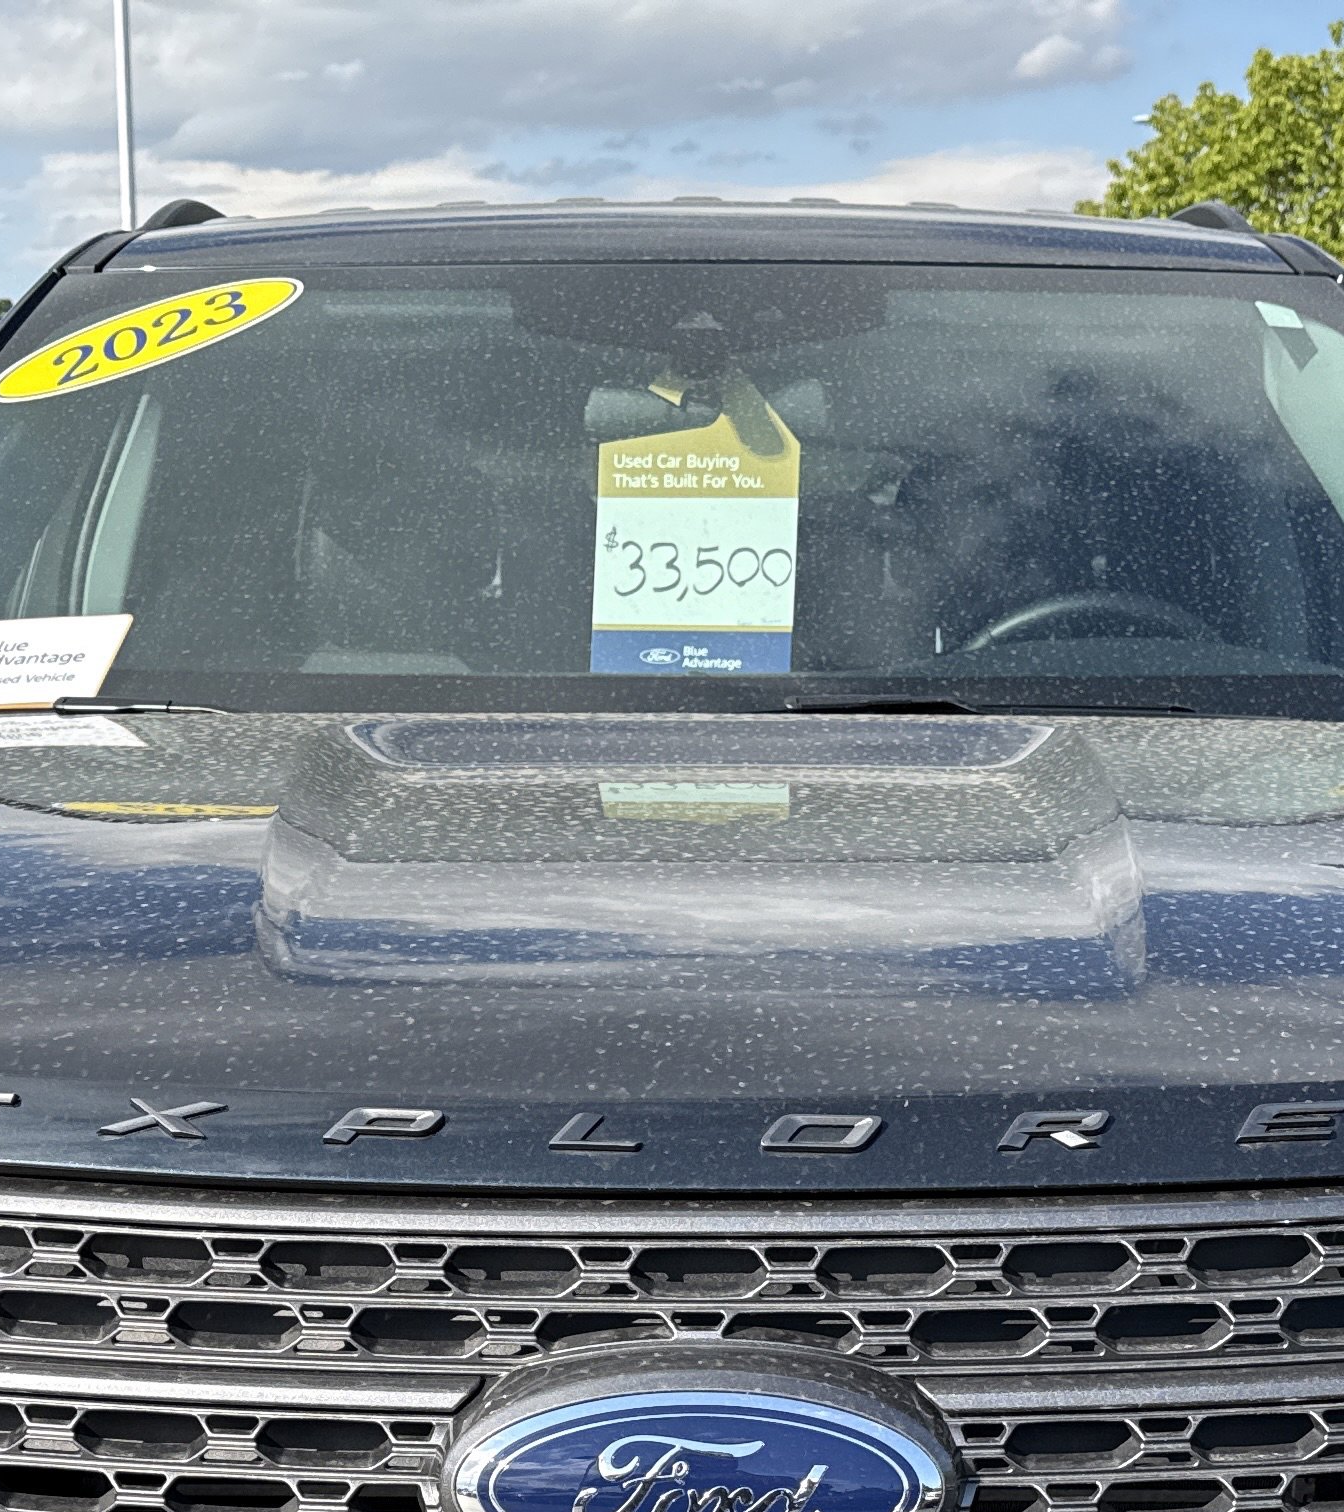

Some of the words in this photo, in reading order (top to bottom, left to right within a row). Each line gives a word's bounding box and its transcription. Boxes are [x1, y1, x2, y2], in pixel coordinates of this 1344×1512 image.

[52, 290, 248, 386] 2023
[613, 453, 653, 469] Used
[656, 453, 682, 469] Car
[686, 453, 740, 471] Buying
[612, 472, 659, 489] That's
[663, 472, 698, 489] Built
[702, 473, 728, 489] For
[730, 473, 766, 489] You.
[604, 526, 793, 602] $33,500
[682, 645, 710, 657] Blue
[681, 657, 743, 671] Advantage
[25, 672, 76, 685] Vehicle
